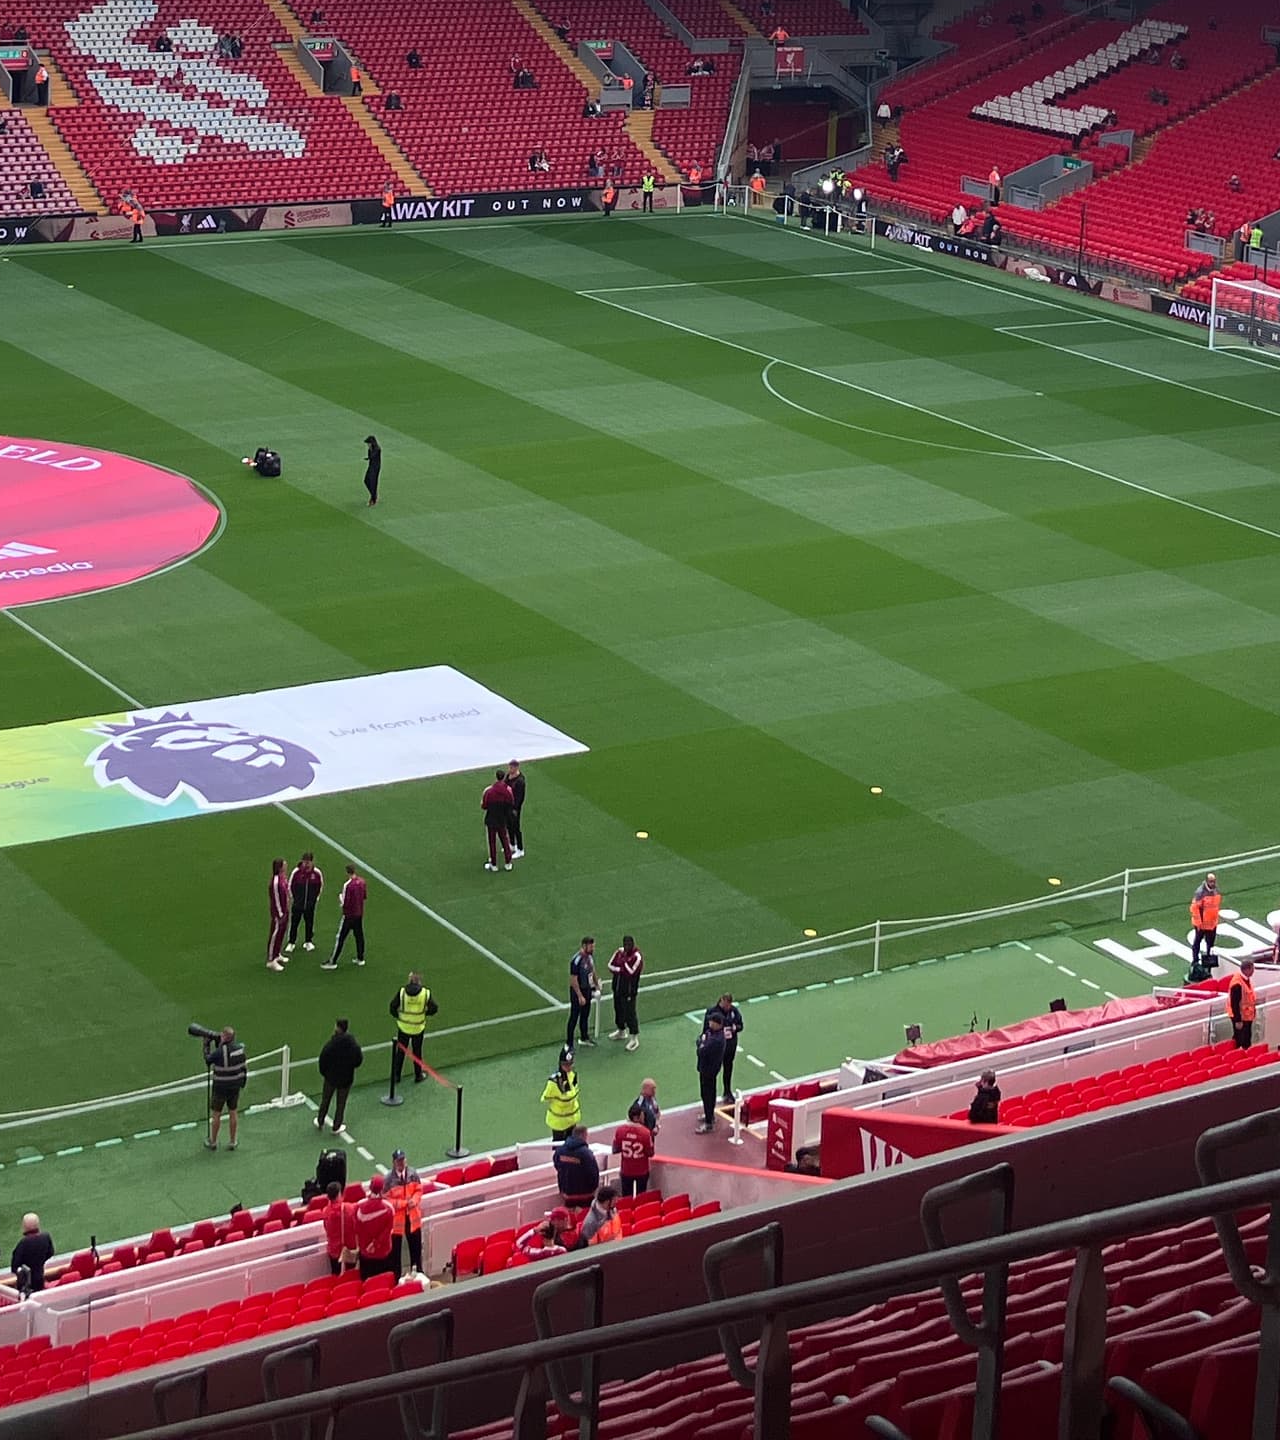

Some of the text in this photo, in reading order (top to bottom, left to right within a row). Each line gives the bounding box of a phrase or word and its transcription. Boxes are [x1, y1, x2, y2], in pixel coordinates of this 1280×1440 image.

[442, 199, 475, 218] KIT
[492, 199, 529, 211] OUT
[543, 197, 582, 209] NOW
[914, 229, 932, 247] KIT
[939, 242, 959, 253] OUT
[965, 248, 987, 261] NOW
[1168, 301, 1206, 326] AWAY
[329, 707, 481, 739] Live from Anfield
[621, 1140, 644, 1159] 52
